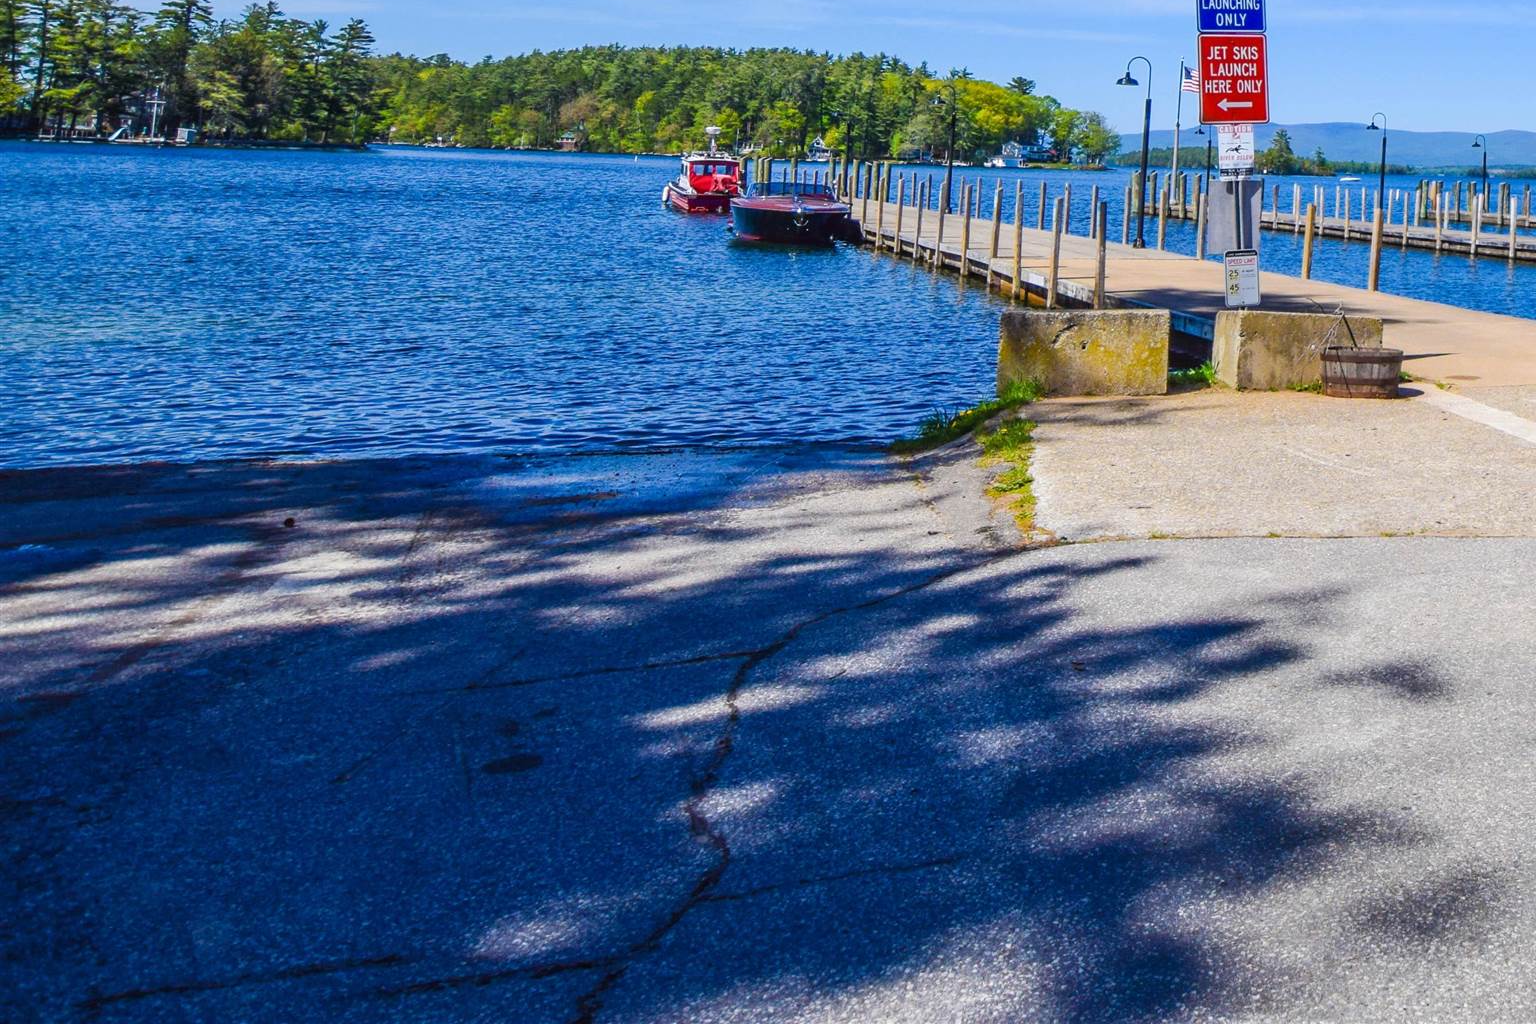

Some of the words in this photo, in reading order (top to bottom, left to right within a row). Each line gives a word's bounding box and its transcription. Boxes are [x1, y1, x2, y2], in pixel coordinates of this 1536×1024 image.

[1215, 13, 1247, 27] ONLY
[1207, 46, 1228, 60] JET
[1233, 46, 1259, 60] SKIS
[1210, 63, 1257, 77] LAUNCH
[1205, 79, 1233, 94] HERE
[1237, 79, 1263, 94] ONLY
[1229, 269, 1239, 277] 25
[1229, 283, 1239, 291] 45
